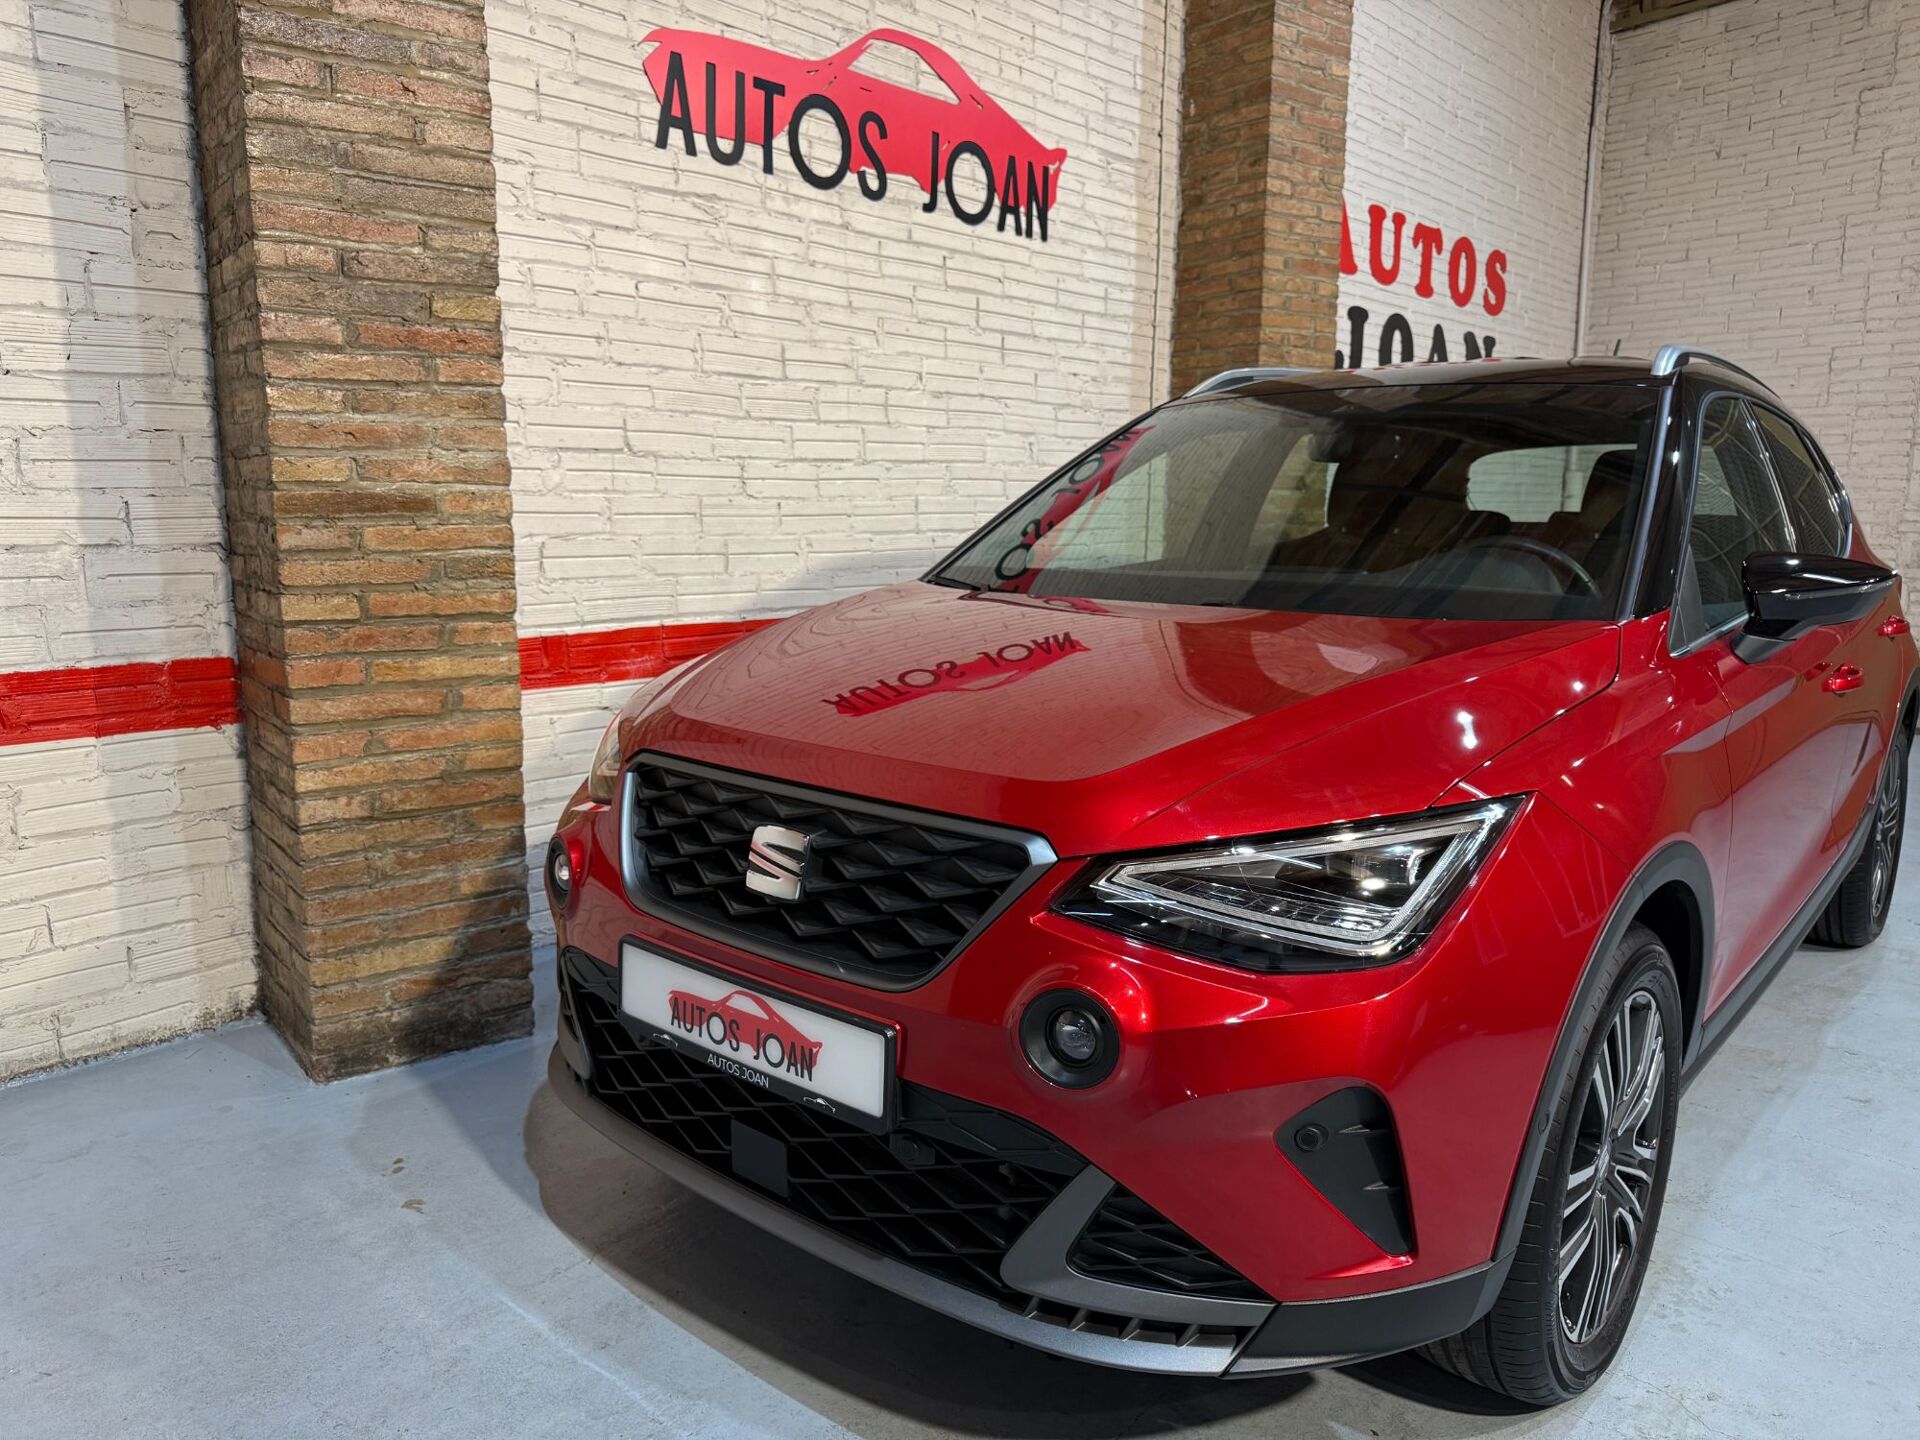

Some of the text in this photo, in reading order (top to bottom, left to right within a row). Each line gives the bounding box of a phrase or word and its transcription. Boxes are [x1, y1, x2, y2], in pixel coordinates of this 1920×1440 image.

[655, 50, 1050, 242] AUTOS JOAN
[670, 997, 814, 1082] AUTOS JOAN
[707, 1053, 769, 1089] AUTOS JOAN
